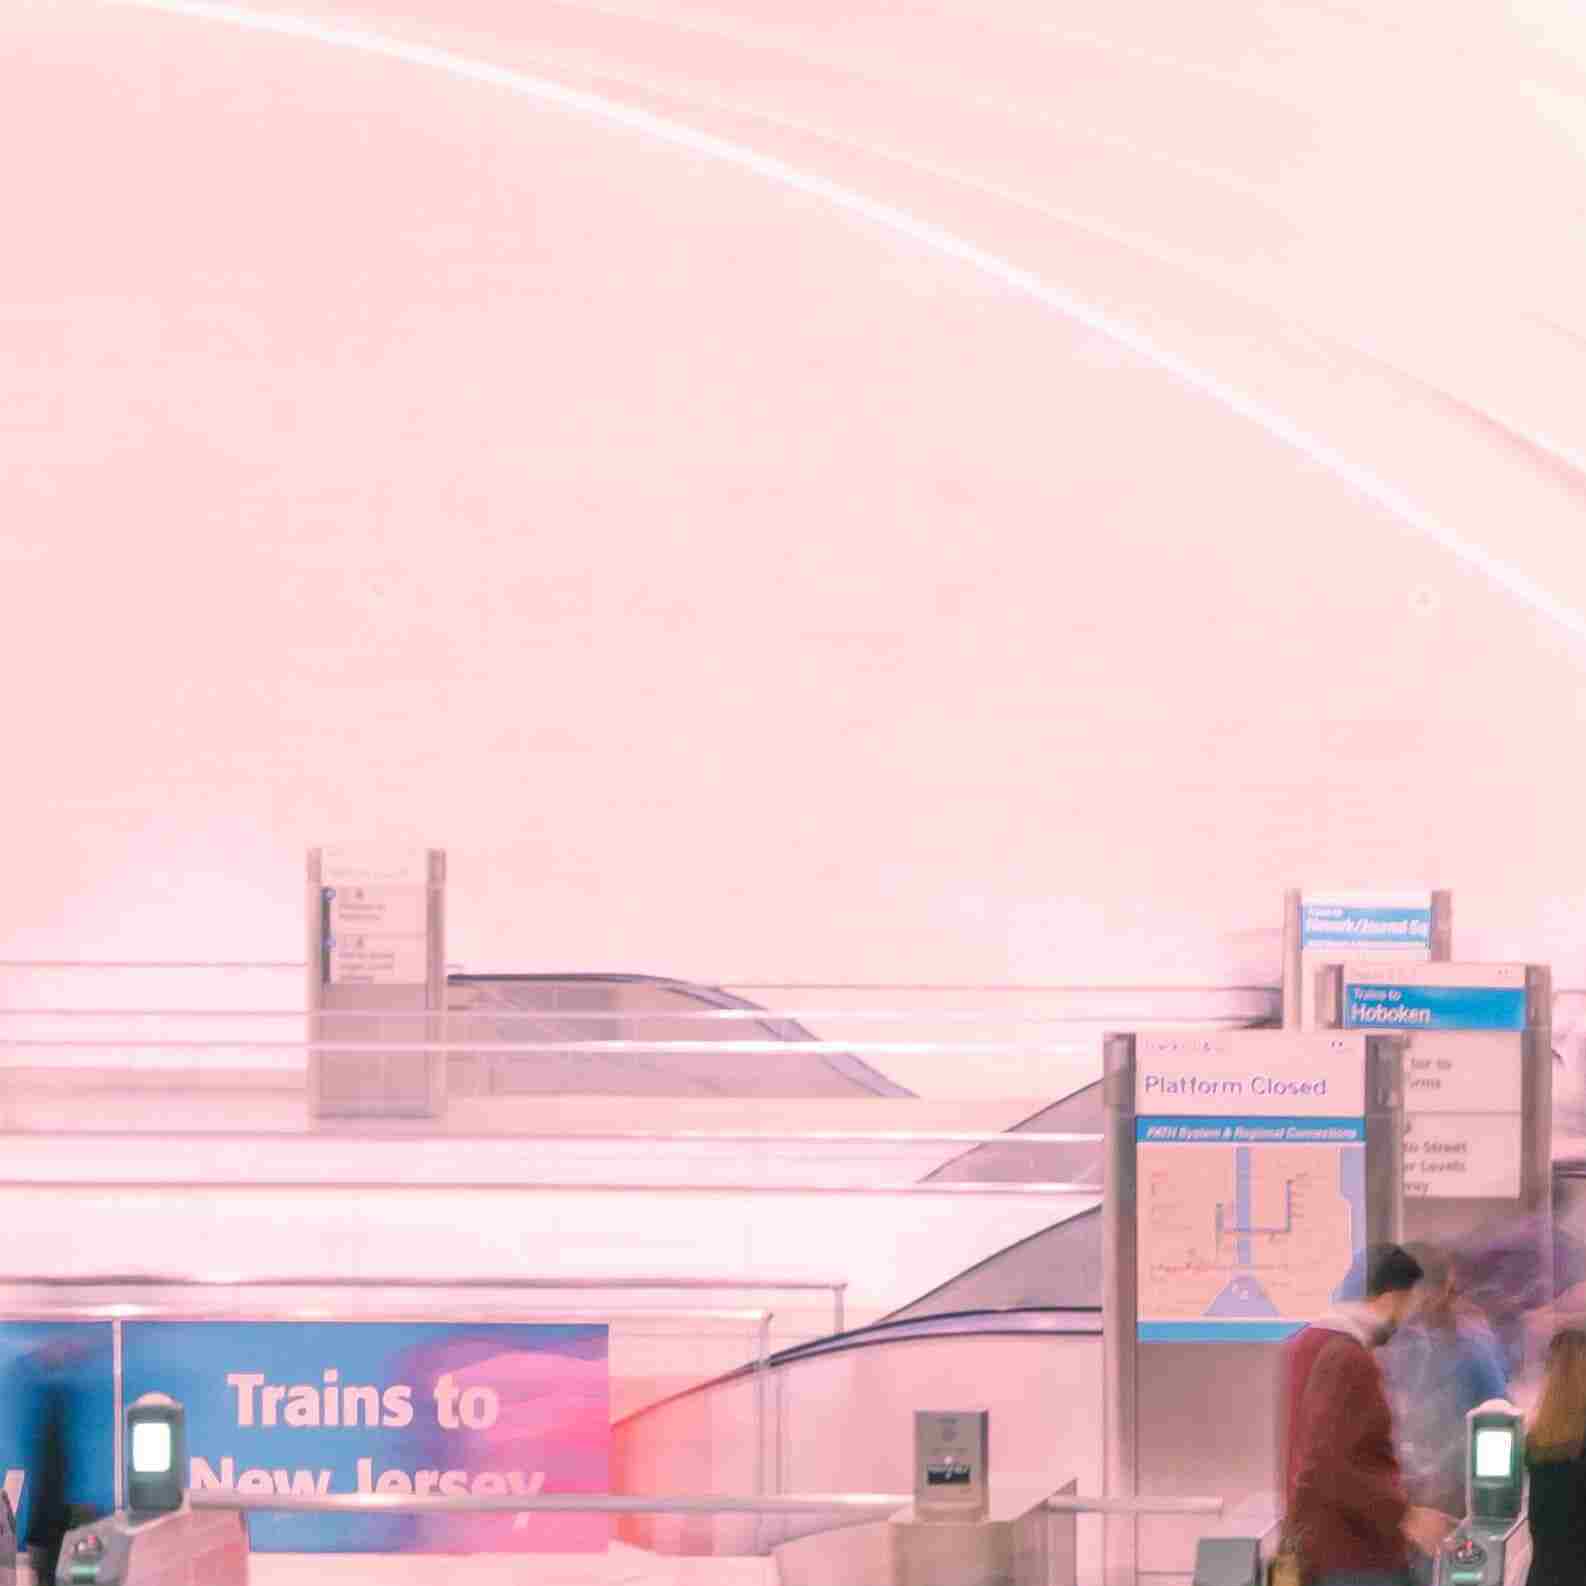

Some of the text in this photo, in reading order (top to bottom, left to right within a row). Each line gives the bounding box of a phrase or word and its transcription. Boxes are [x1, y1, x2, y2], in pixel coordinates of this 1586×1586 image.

[1351, 1003, 1431, 1024] Hoboken
[1145, 1075, 1328, 1096] Platform Closed
[226, 1369, 499, 1429] Trains to
[190, 1456, 545, 1529] New Jersey
